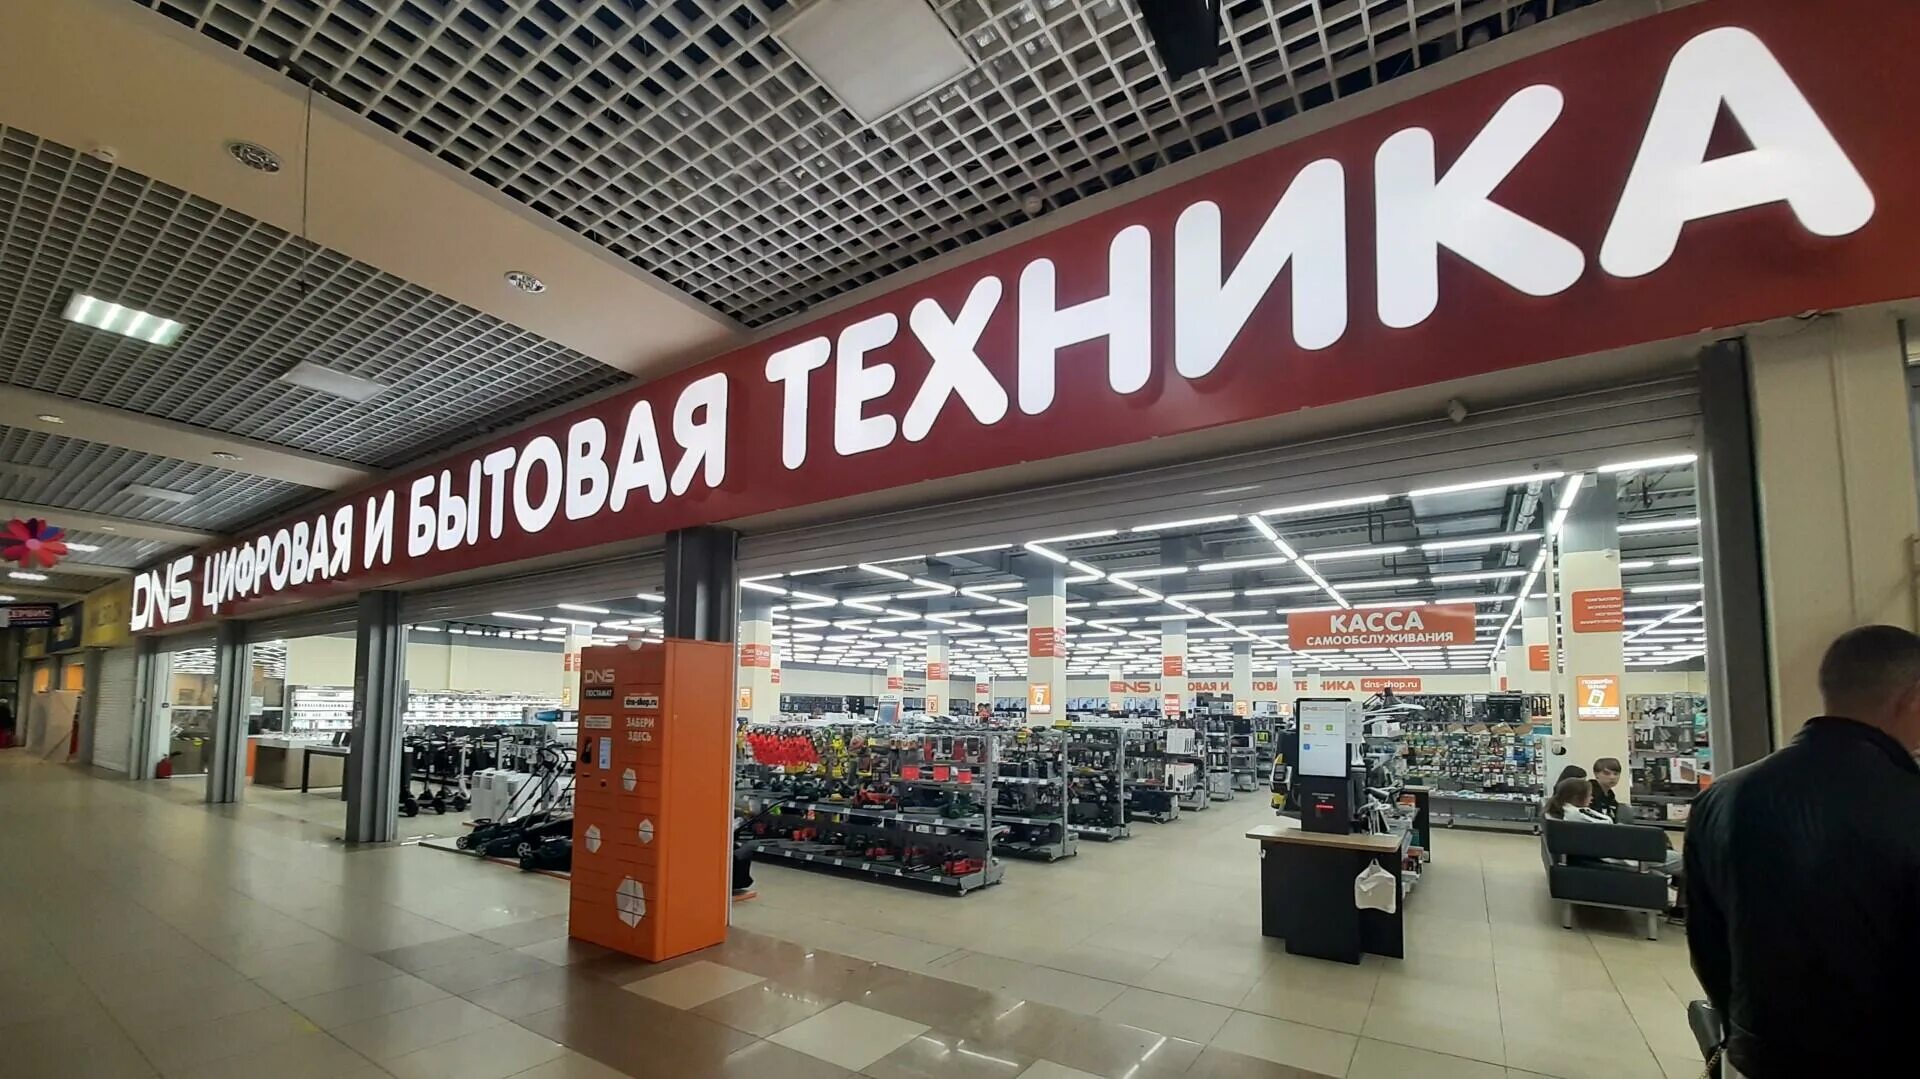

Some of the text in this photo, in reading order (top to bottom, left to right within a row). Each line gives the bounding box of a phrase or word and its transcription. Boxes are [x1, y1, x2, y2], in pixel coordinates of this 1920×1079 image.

[130, 27, 1874, 631] DNS ЦИФРОВАЯ И БЫТОВАЯ ТЕХНИКА
[1330, 610, 1424, 634] КАССА
[1306, 632, 1454, 646] САМООБСЛУЖИВАНИЯ
[584, 669, 615, 683] DNS
[1221, 681, 1229, 691] И
[1364, 680, 1418, 690] dns-shop.ru
[585, 689, 612, 697] ПОСТАМАТ
[626, 717, 655, 728] ЗАБЕРИ
[628, 731, 652, 742] ЗДЕСЬ
